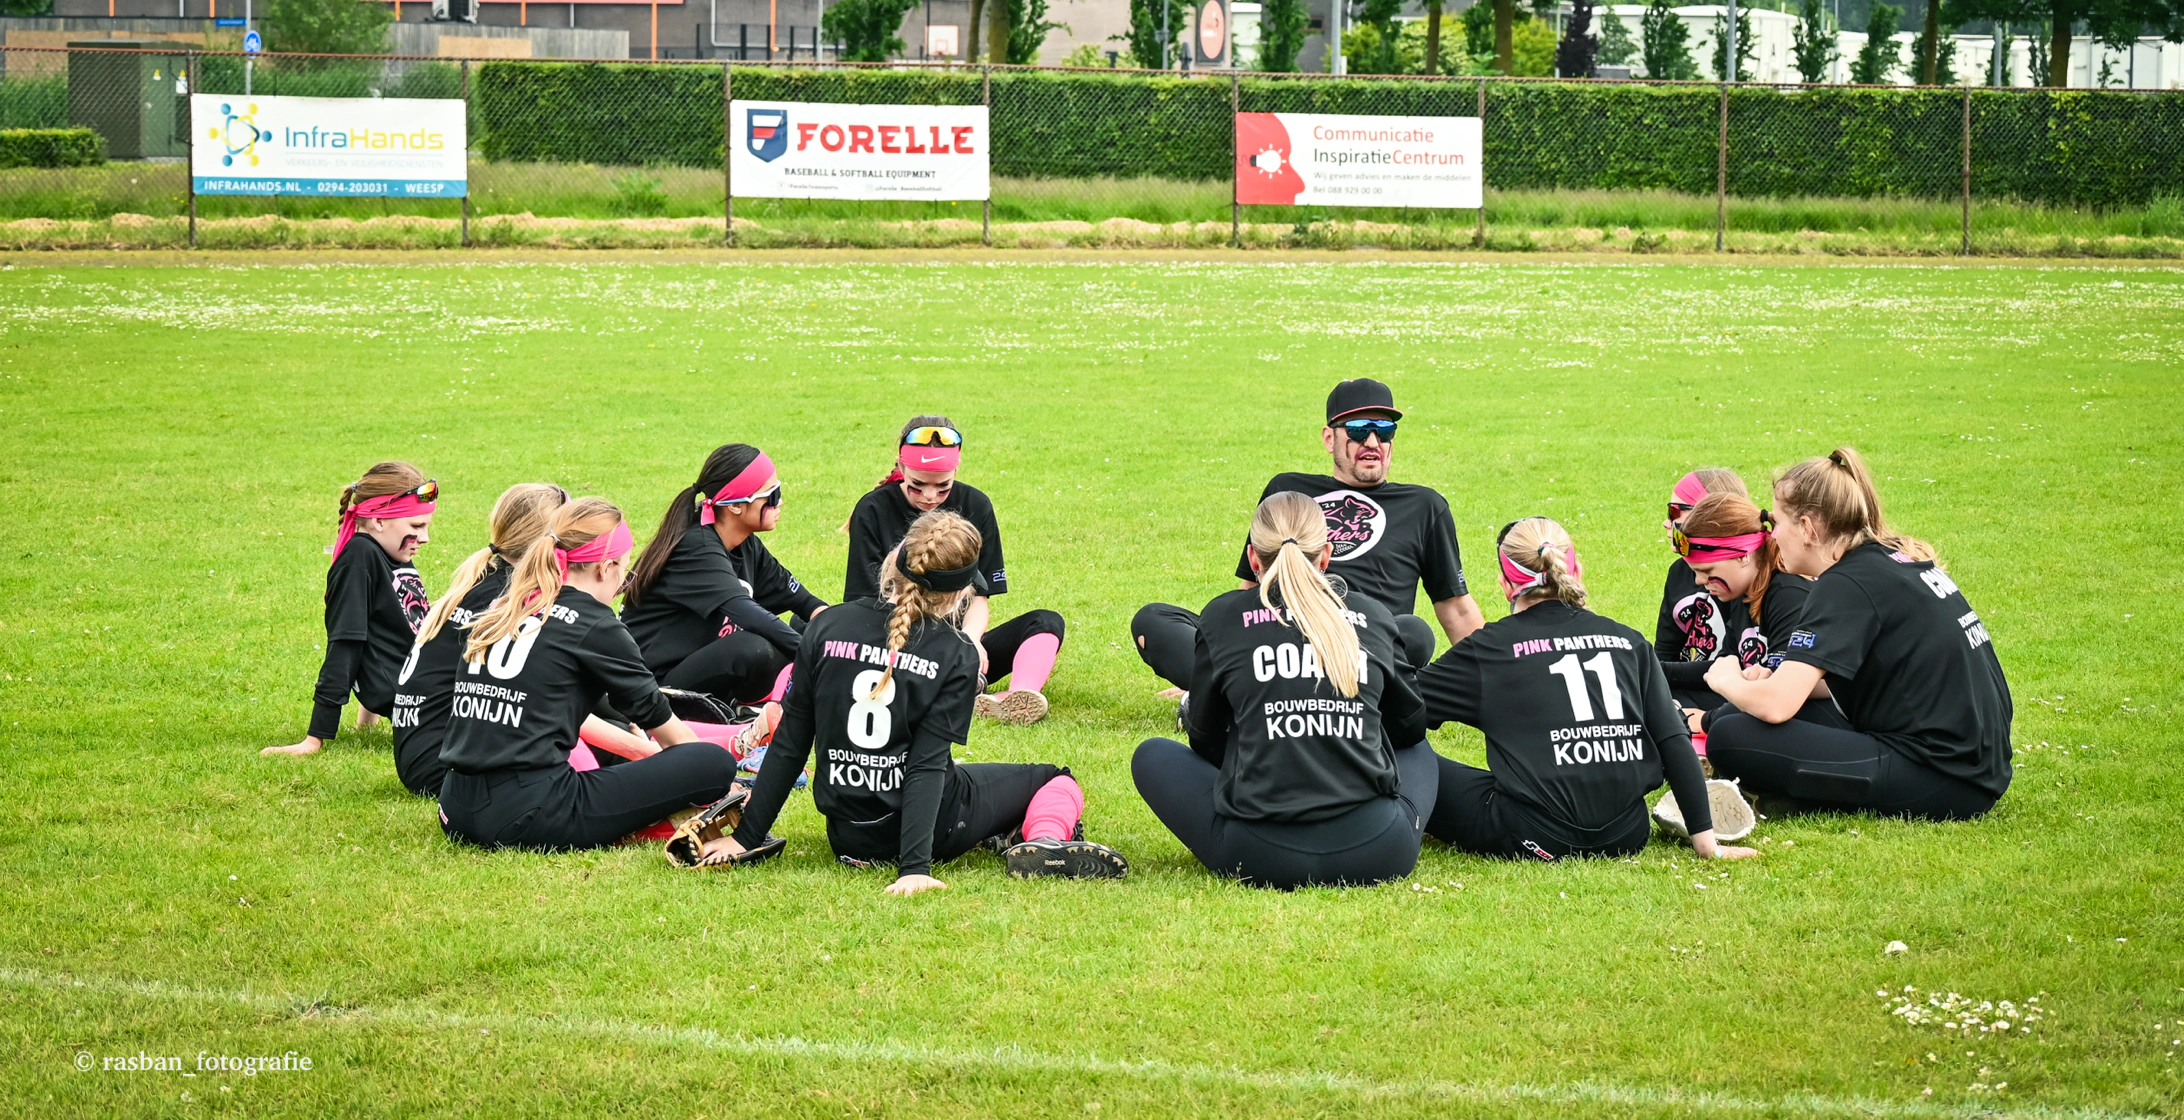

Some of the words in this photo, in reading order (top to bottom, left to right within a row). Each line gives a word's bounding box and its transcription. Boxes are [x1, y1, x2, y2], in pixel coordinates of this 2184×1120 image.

[285, 126, 444, 150] InfraHands
[797, 123, 974, 154] FORELLE
[1313, 125, 1434, 143] Communicatie
[1314, 148, 1464, 167] InspiratieCentrum
[784, 167, 829, 177] BASEBALL
[831, 169, 837, 177] &
[839, 168, 883, 178] SOFTBALL
[886, 170, 936, 180] EQUIPMENT
[1313, 172, 1327, 181] Wij
[1355, 173, 1380, 181] advies
[1394, 173, 1420, 181] maken
[1435, 174, 1472, 182] middelen
[204, 180, 302, 193] INFRAHANDS.NL
[317, 182, 389, 193] 0294-203031
[405, 183, 445, 194] WEESP
[824, 641, 859, 660] PINK
[1513, 639, 1552, 658] PINK
[1553, 634, 1633, 651] PANTHERS
[454, 681, 527, 703] BOUWBEDRIJF
[1549, 651, 1625, 722] 11
[847, 669, 896, 749] 8
[1264, 699, 1364, 715] BOUWBEDRIJF
[1266, 714, 1364, 740] KONIJN
[1550, 724, 1642, 742] BOUWBEDRIJF
[1553, 738, 1643, 765] KONIJN
